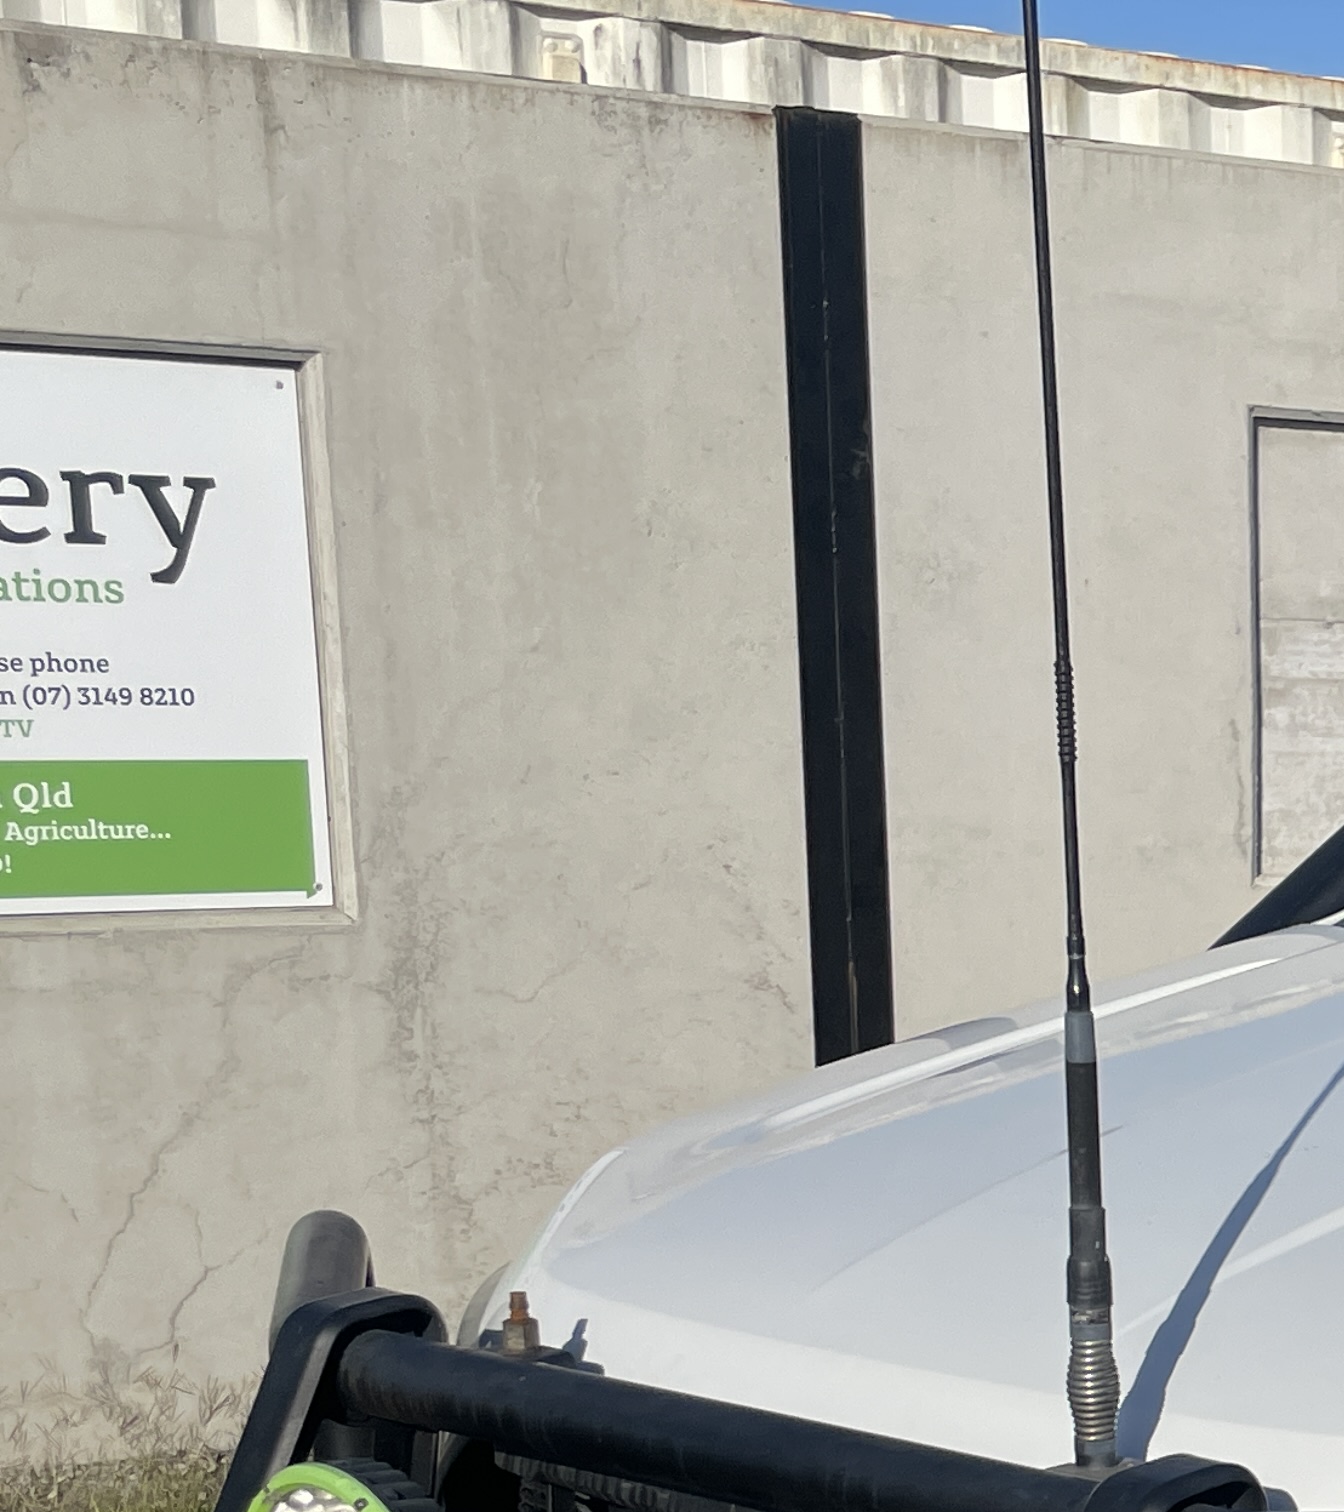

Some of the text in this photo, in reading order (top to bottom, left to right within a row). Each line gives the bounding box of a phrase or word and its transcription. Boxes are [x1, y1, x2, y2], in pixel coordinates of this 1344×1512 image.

[0, 467, 216, 585] ery
[29, 651, 110, 677] phone
[22, 684, 72, 710] (07)
[77, 686, 133, 706] 3149
[140, 687, 196, 707] 8210
[12, 781, 74, 814] Qld
[4, 818, 172, 846] Agriculture...
